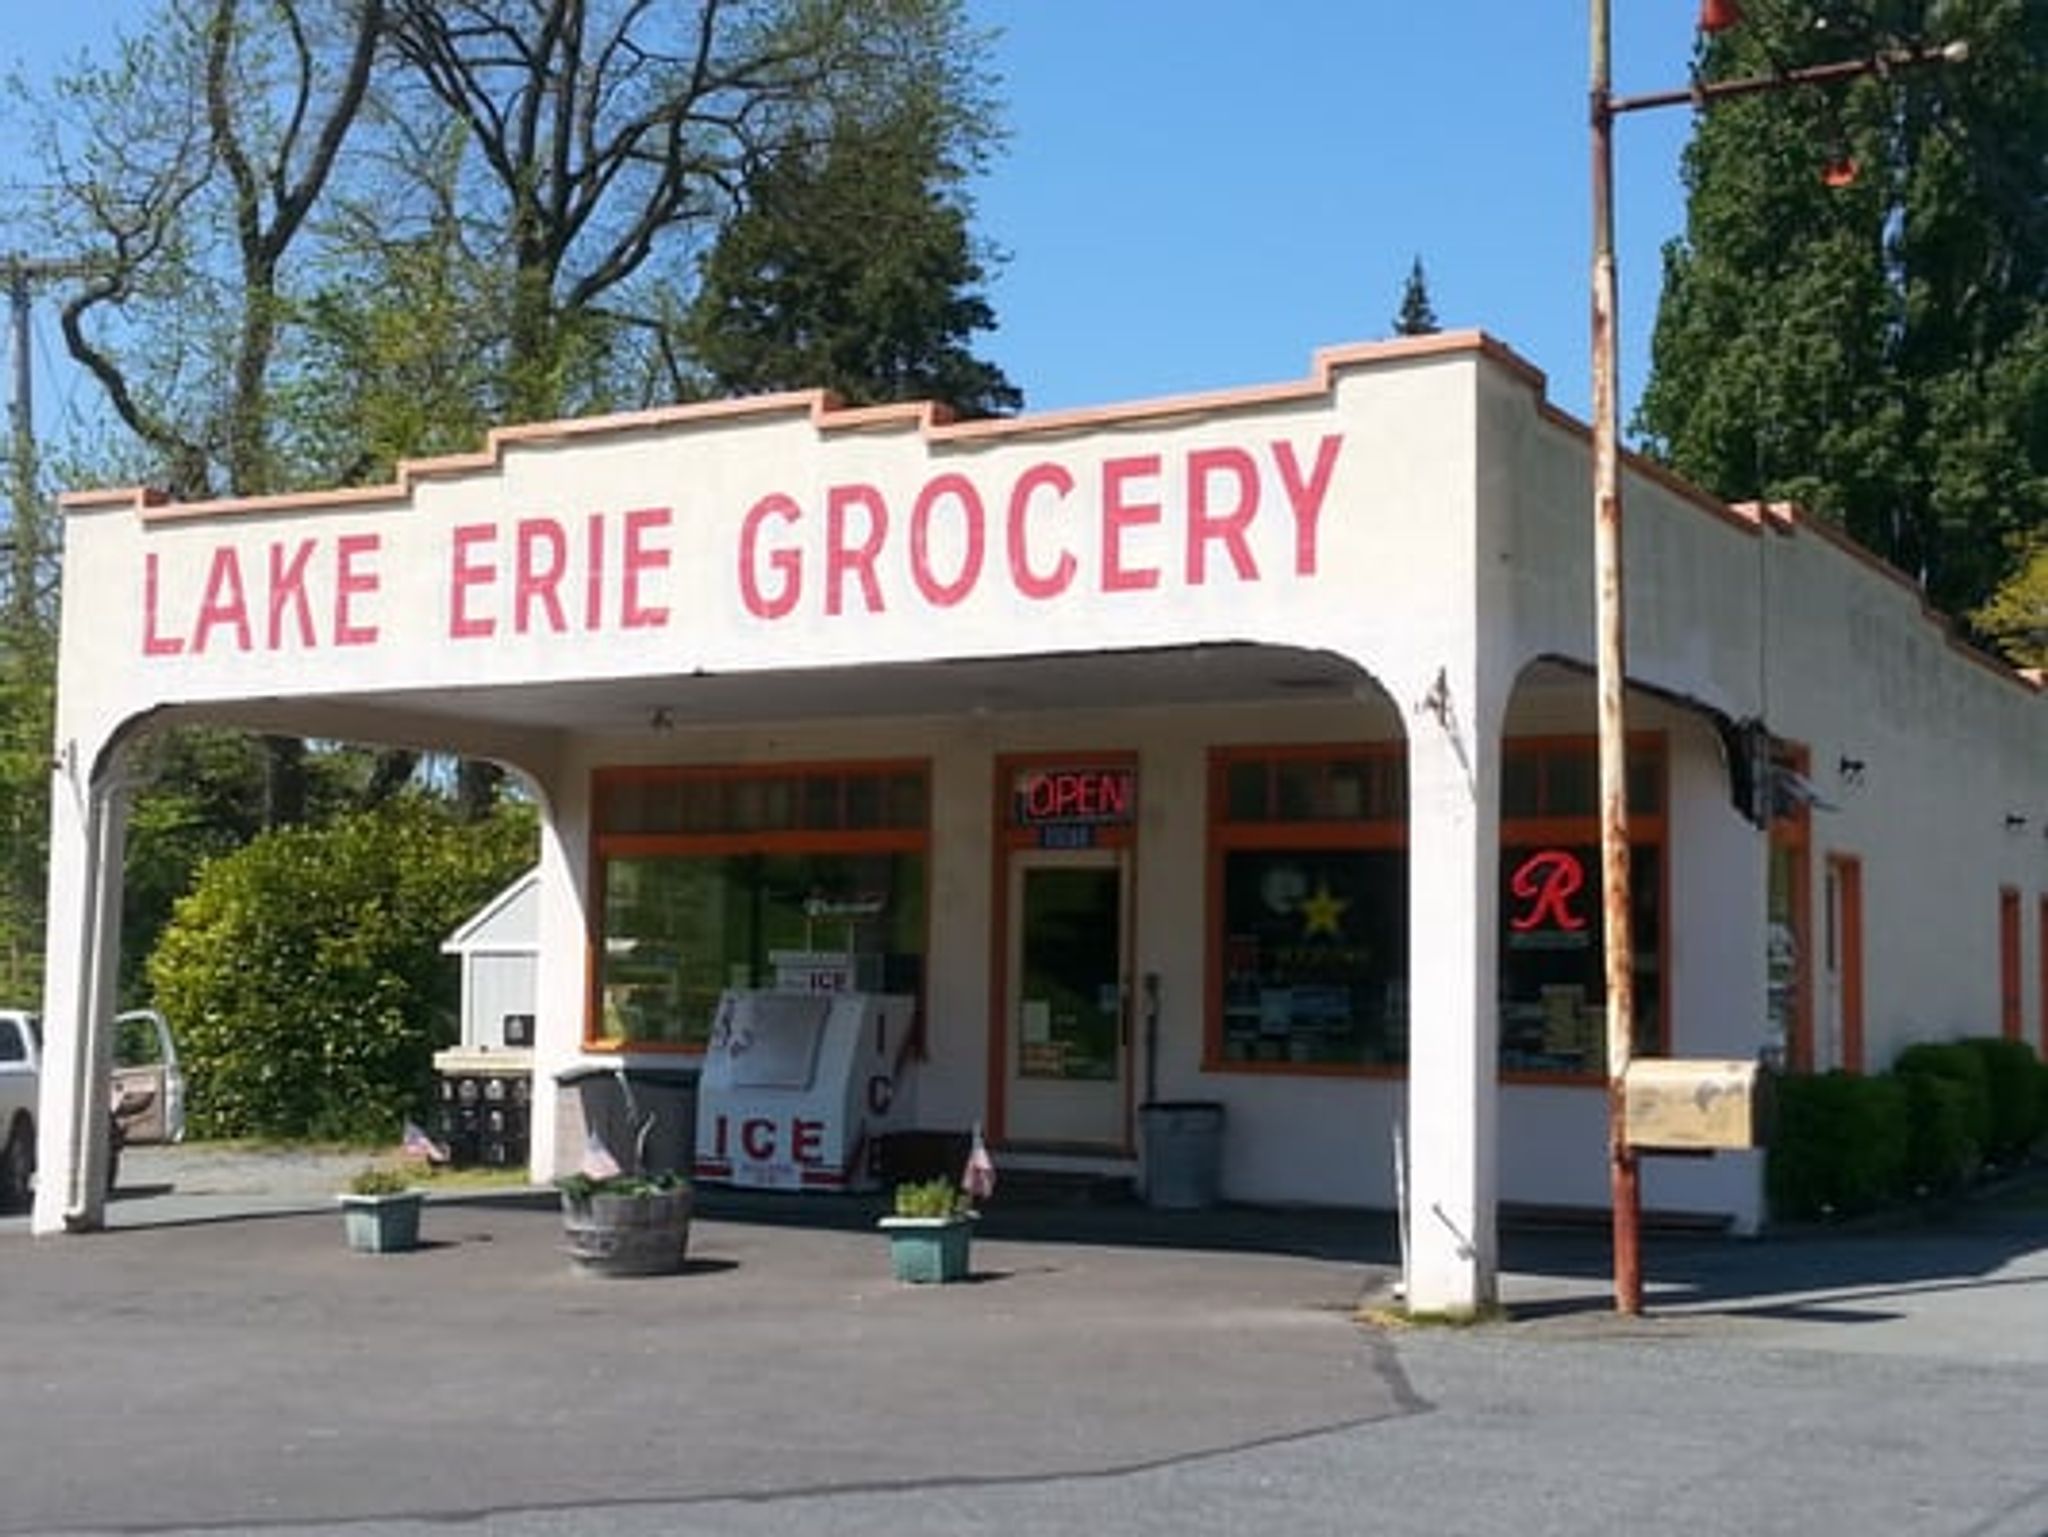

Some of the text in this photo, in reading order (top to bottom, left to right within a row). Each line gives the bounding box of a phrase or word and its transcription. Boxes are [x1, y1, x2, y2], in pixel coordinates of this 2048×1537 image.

[142, 434, 1344, 656] LAKE ERIE GROCERY
[1030, 775, 1129, 816] OPEN
[1511, 851, 1585, 932] R
[810, 972, 847, 989] ICE
[714, 1114, 826, 1164] ICE
